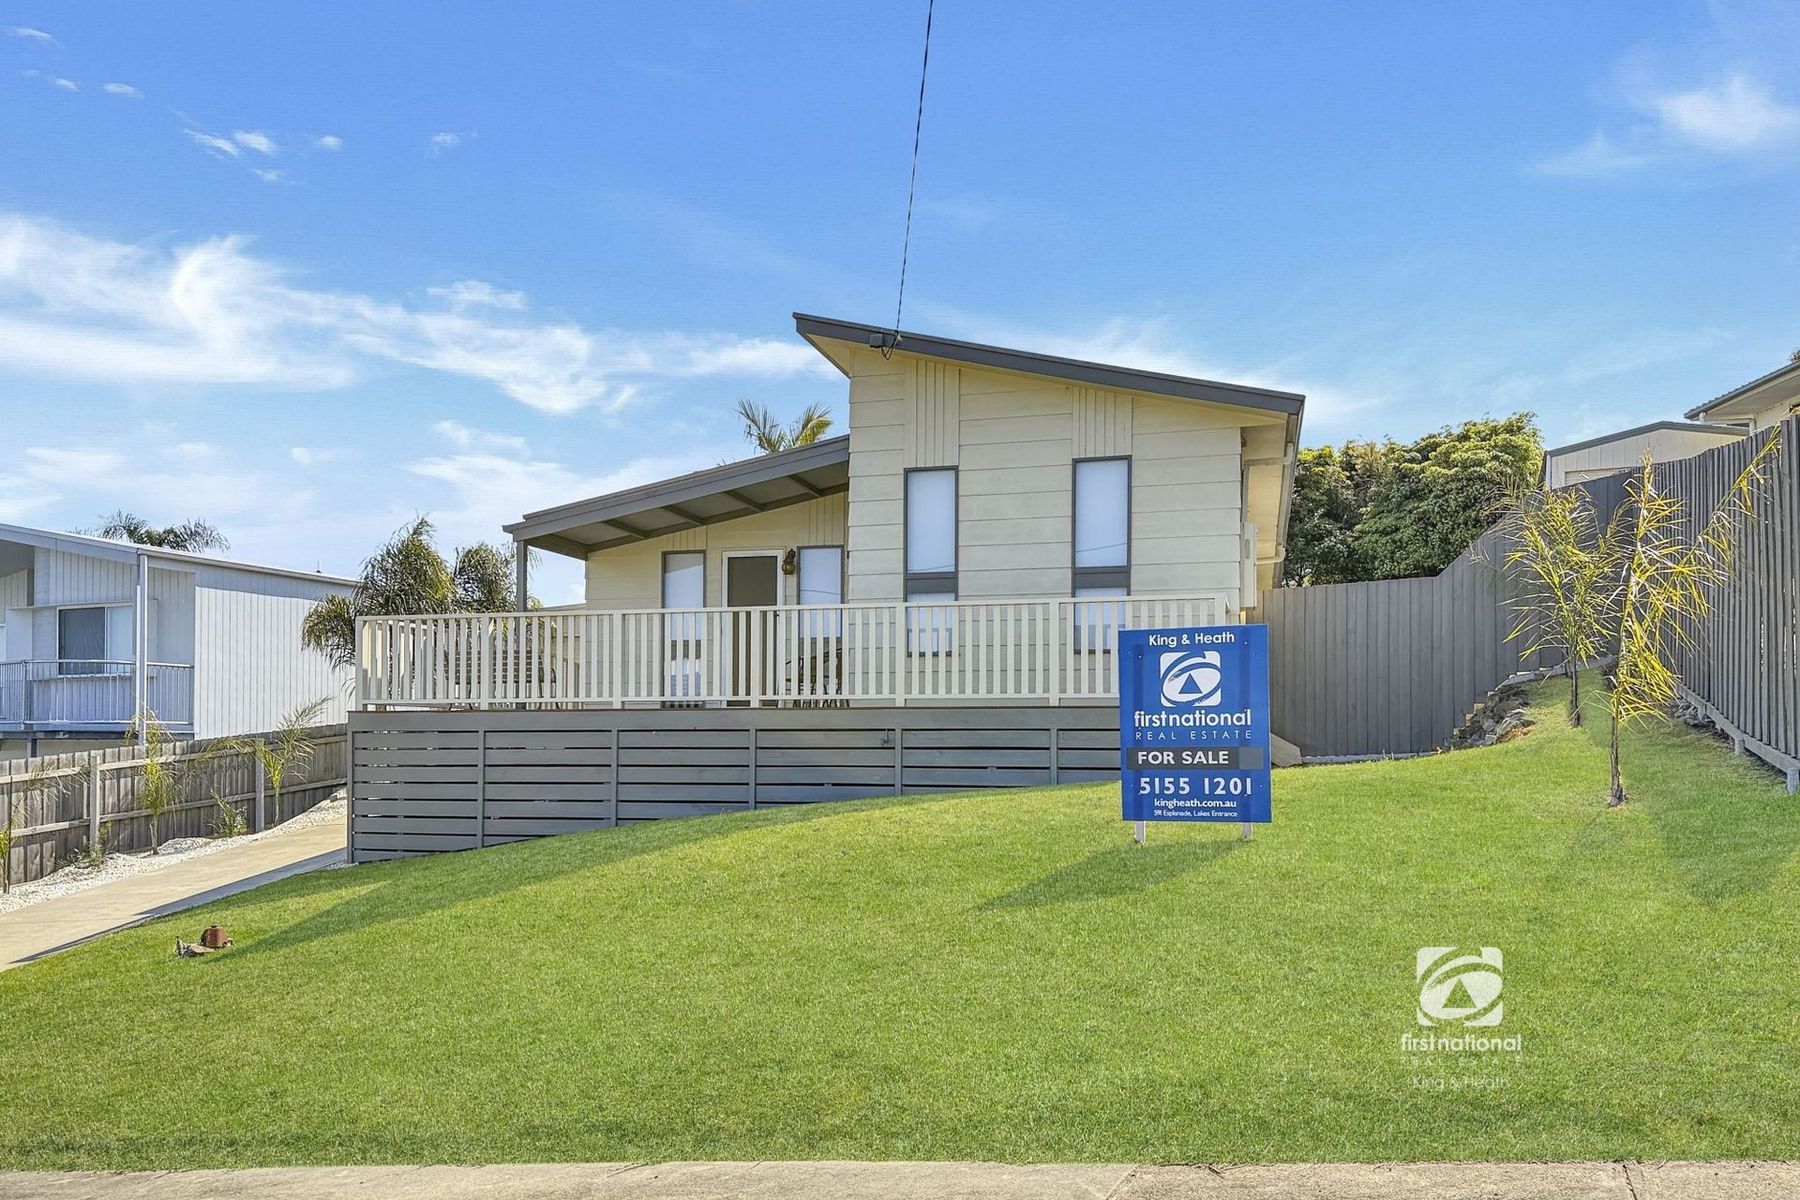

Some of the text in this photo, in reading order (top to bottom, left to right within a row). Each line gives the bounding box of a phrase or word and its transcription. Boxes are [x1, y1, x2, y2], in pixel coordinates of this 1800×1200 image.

[1149, 631, 1235, 648] King & Heath
[1135, 730, 1252, 740] REAL ESTATE
[1137, 750, 1229, 764] FOR SALE
[1139, 777, 1252, 795] 5155 1201
[1154, 798, 1237, 809] kingheath.com.au
